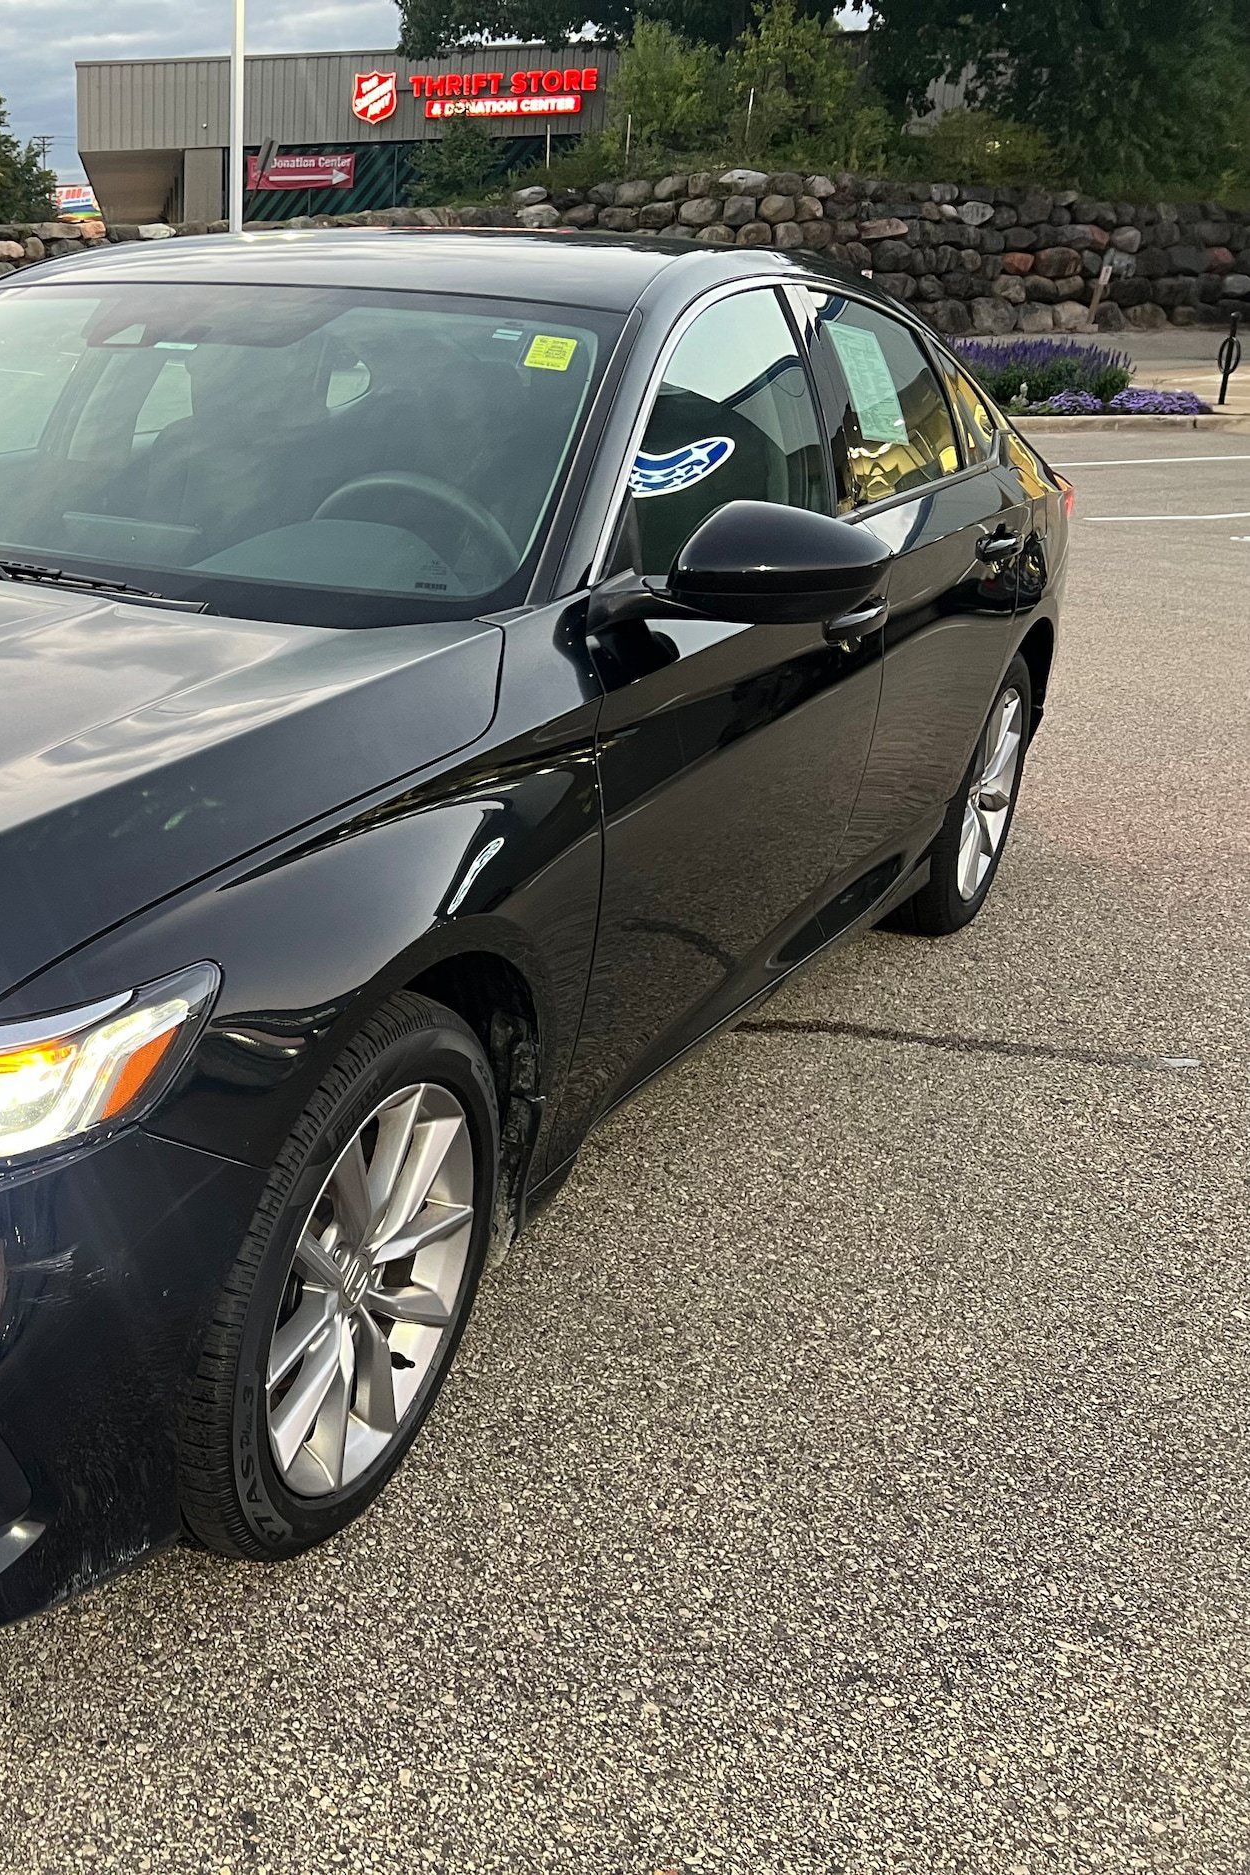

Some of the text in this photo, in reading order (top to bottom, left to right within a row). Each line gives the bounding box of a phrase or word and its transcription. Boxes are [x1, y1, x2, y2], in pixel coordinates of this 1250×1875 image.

[409, 73, 504, 98] THRIFT
[510, 68, 598, 94] STORE
[431, 98, 575, 116] & DONATION CENTER
[318, 156, 352, 168] Center
